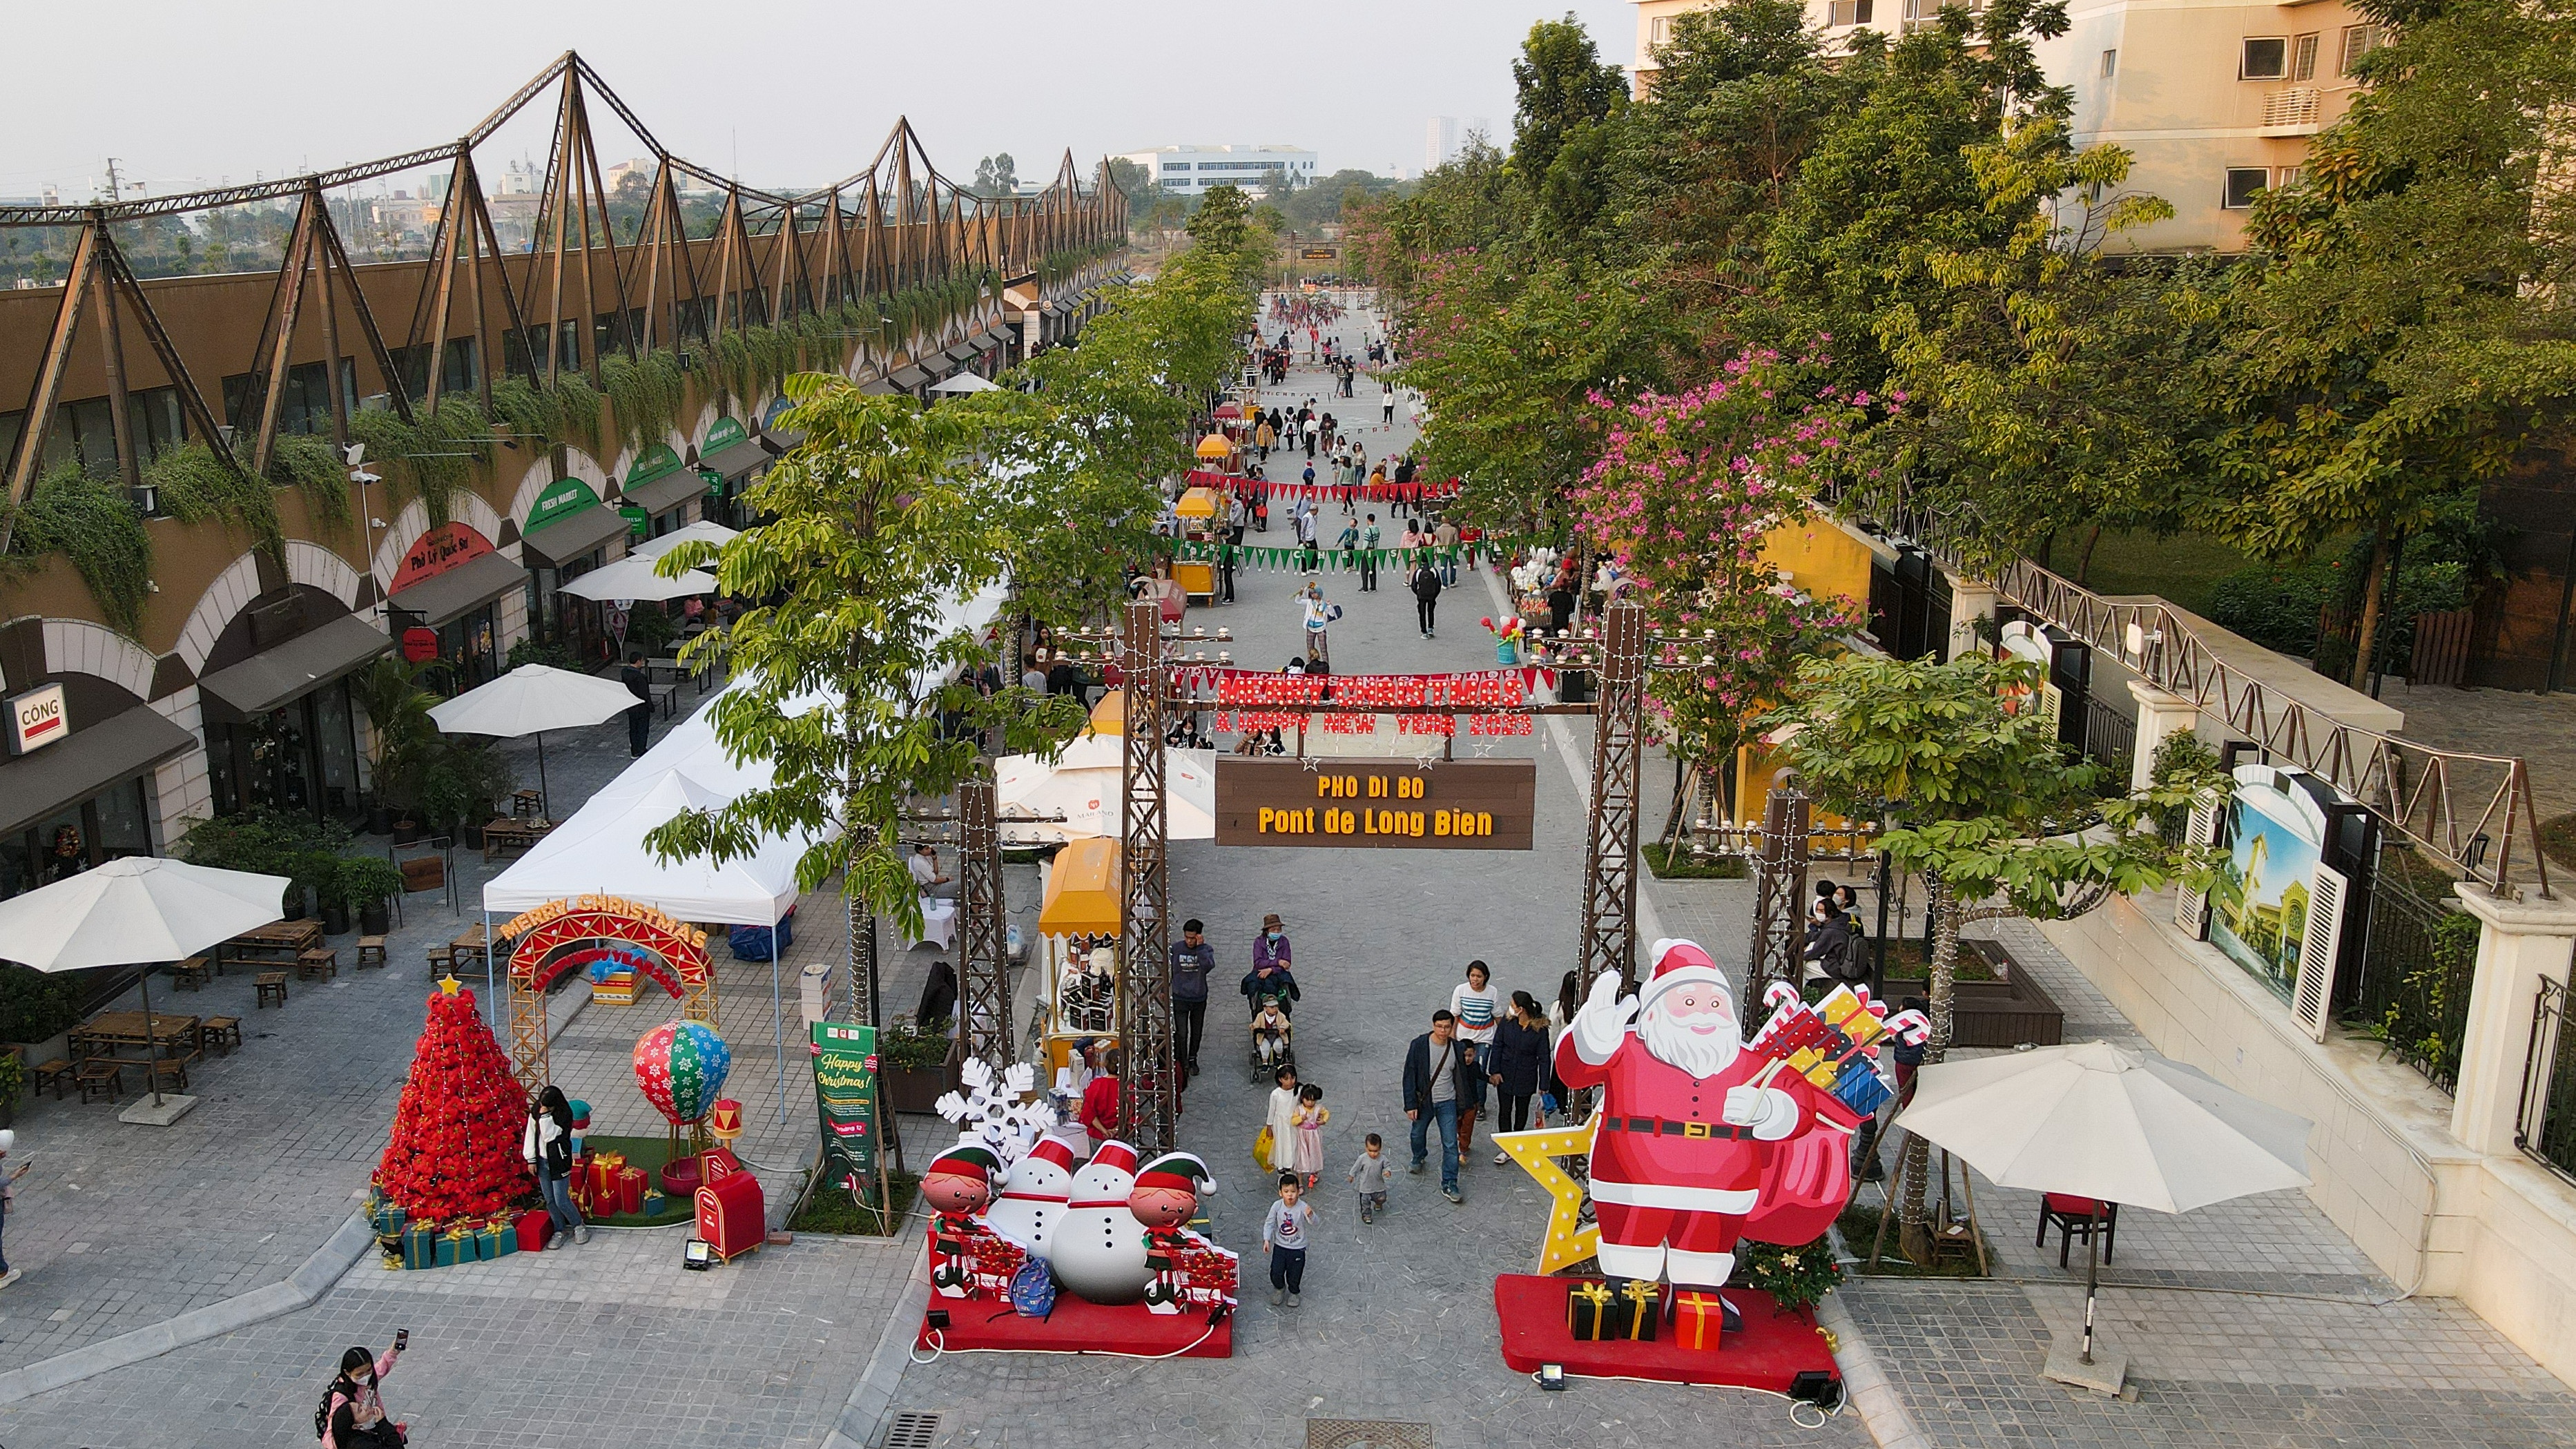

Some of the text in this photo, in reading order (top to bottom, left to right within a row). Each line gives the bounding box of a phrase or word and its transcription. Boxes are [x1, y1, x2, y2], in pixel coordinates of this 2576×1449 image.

[541, 489, 578, 512] FRESH MARKET
[1219, 677, 1523, 707] MERRY CHRISTMAS
[22, 699, 59, 726] CỘNG
[1215, 712, 1533, 737] & HAPPY NEW YEAR 2023
[1317, 775, 1425, 799] PHO DI BO
[1258, 806, 1493, 837] Pont de Long Bien
[499, 893, 708, 949] MERRY CHRISTMAS
[822, 1053, 863, 1073] Happy
